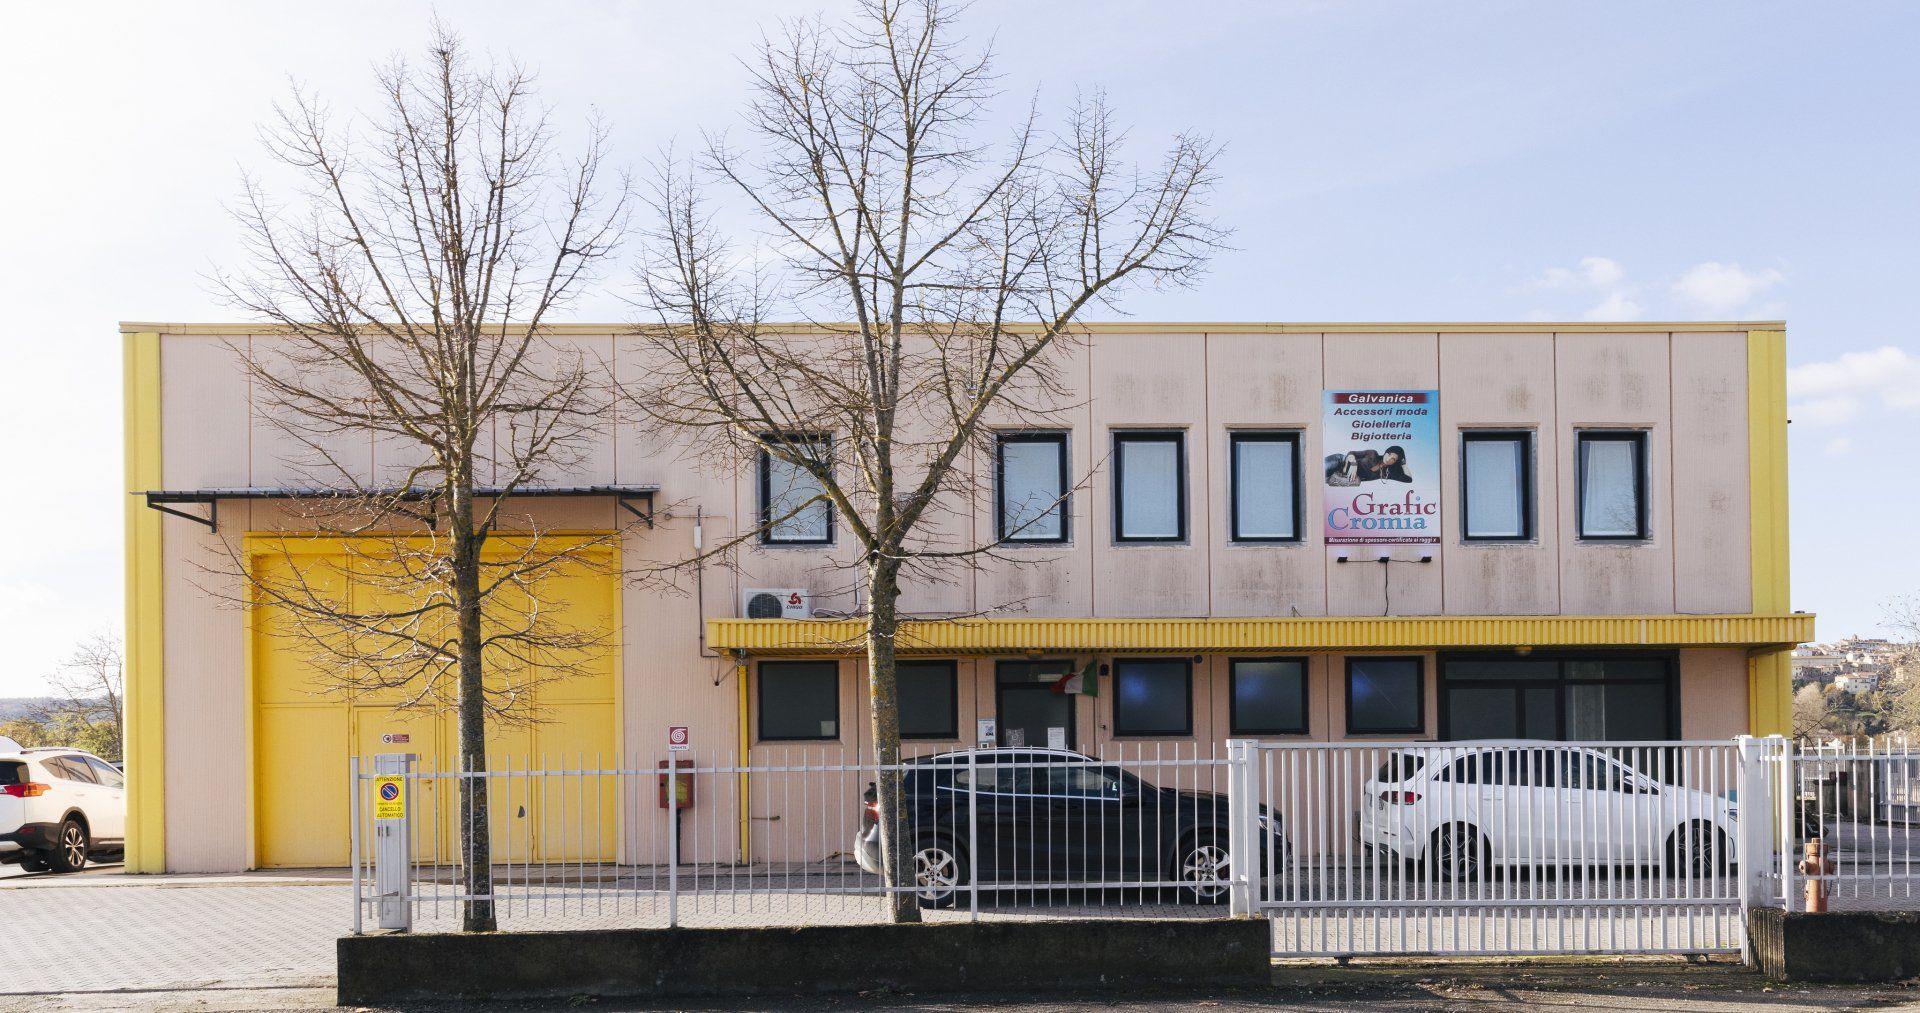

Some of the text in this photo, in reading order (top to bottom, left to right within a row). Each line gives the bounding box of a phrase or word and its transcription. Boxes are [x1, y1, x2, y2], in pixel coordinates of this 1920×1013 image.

[1348, 394, 1413, 403] Galvanica
[1334, 407, 1428, 416] Accessori moda
[1352, 420, 1412, 429] Gioielleria
[1351, 432, 1412, 442] Bigiotteria
[1352, 489, 1437, 516] Grafic
[1327, 506, 1428, 531] Cromia
[1419, 537, 1433, 545] raggi
